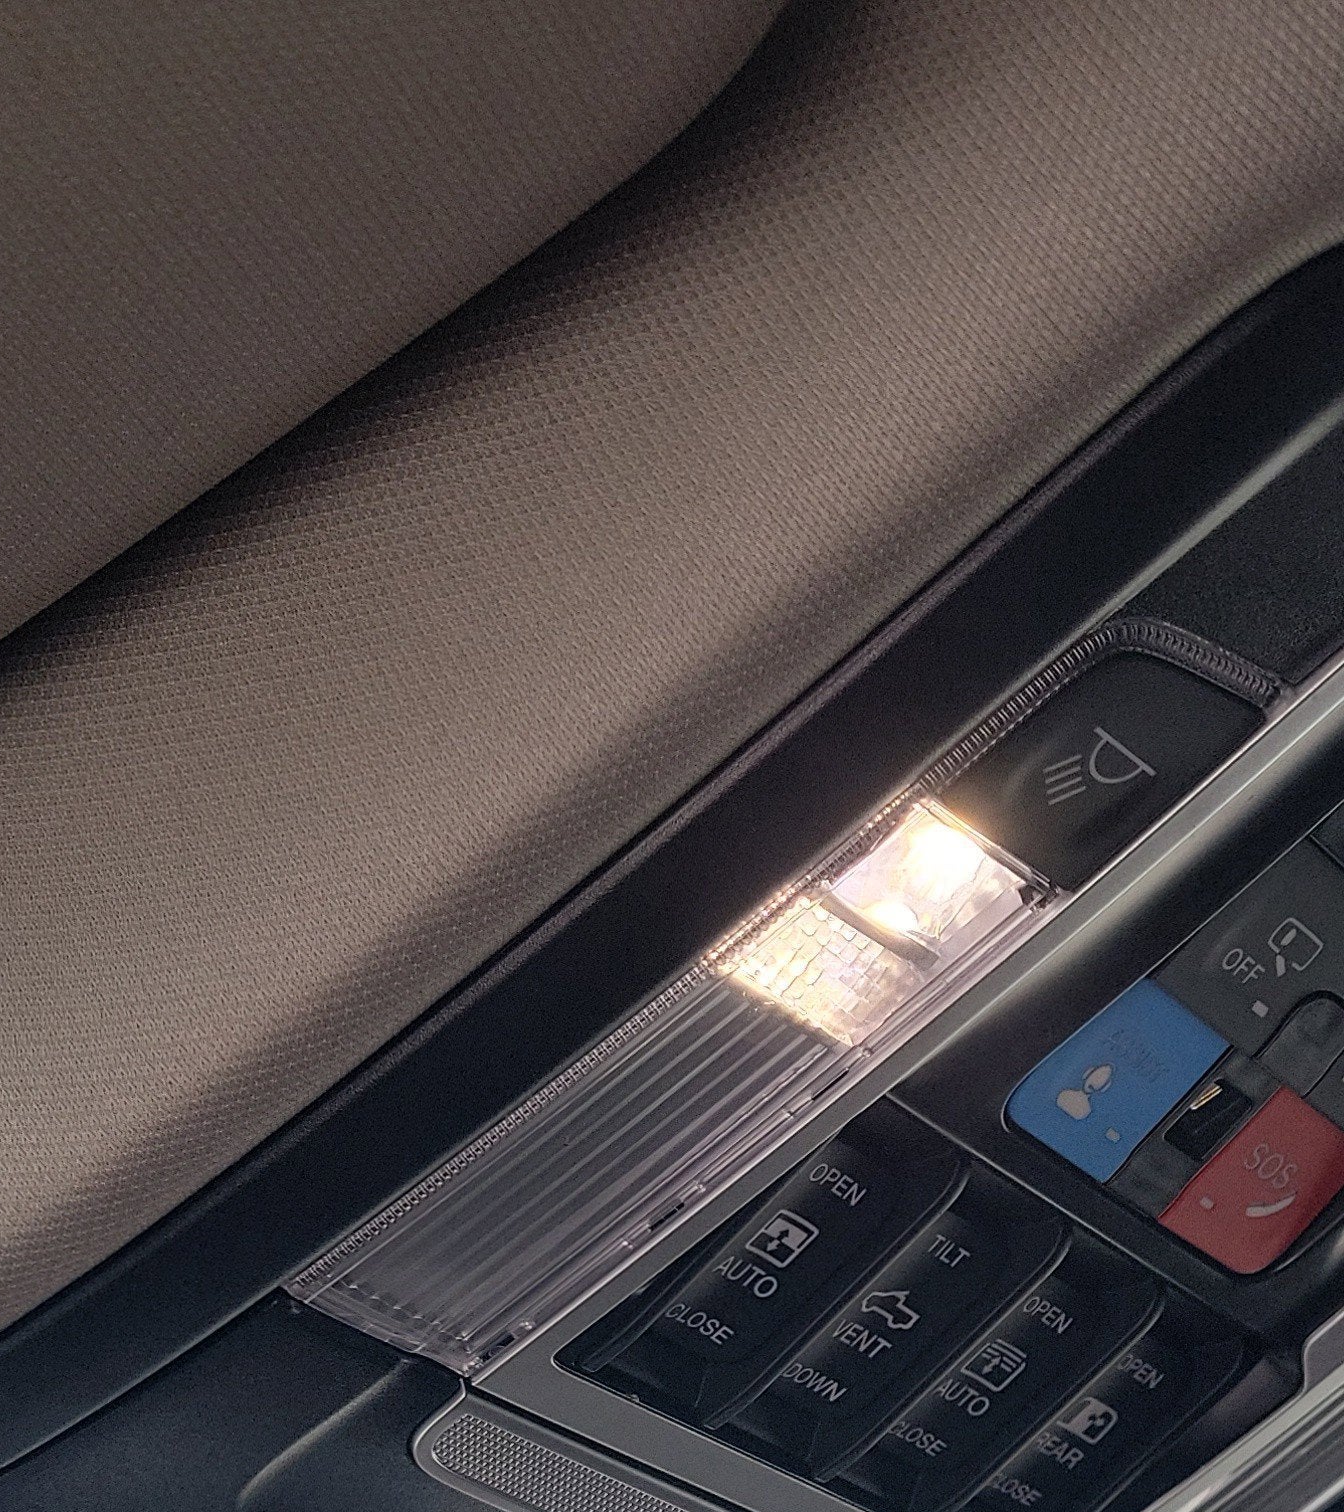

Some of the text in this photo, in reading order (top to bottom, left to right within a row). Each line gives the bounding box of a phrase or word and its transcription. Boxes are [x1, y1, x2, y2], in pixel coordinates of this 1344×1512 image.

[1221, 948, 1266, 984] OFF
[809, 1163, 867, 1207] OPEN
[1243, 1142, 1299, 1190] SOS
[927, 1234, 971, 1268] TILT
[712, 1255, 779, 1298] AUTO
[664, 1303, 735, 1345] CLOSE
[1022, 1296, 1074, 1334] OPEN
[831, 1319, 893, 1359] VENT
[781, 1362, 848, 1402] DOWN
[1116, 1353, 1164, 1389] OPEN
[932, 1378, 991, 1416] AUTO
[886, 1419, 948, 1457] CLOSE
[1035, 1431, 1085, 1470] REAR
